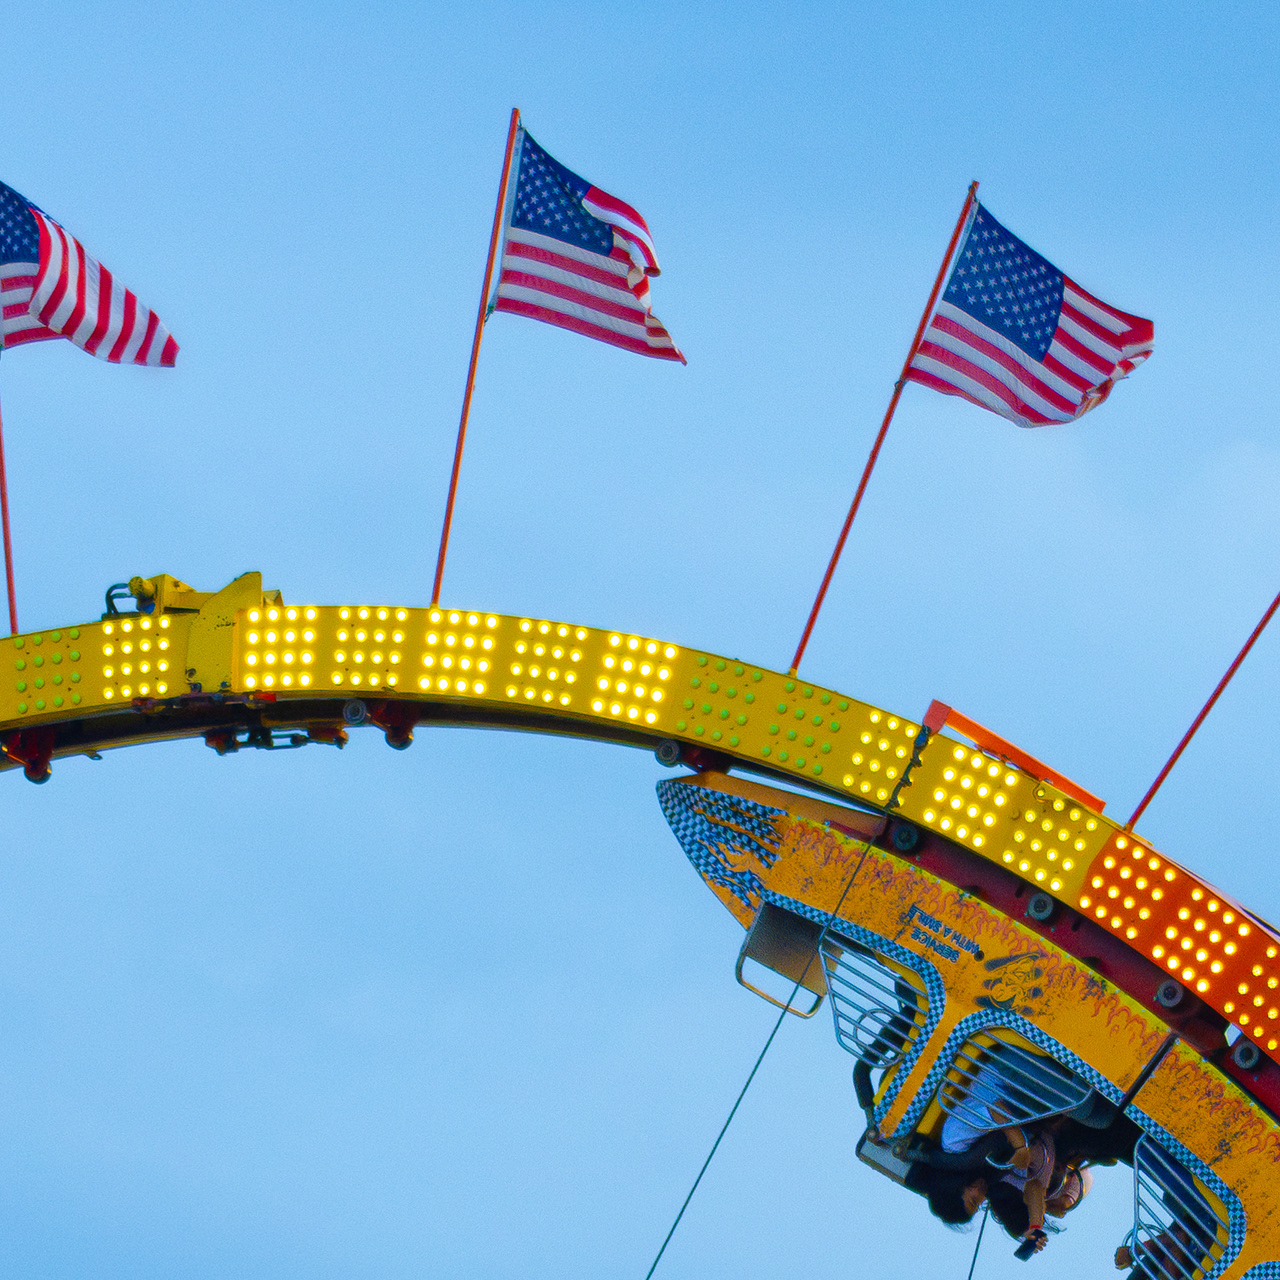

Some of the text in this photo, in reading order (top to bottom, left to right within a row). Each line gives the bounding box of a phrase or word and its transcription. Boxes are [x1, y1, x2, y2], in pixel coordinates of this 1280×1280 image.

[943, 925, 953, 938] A
[951, 930, 980, 955] WITH
[910, 927, 960, 964] SERVICE
